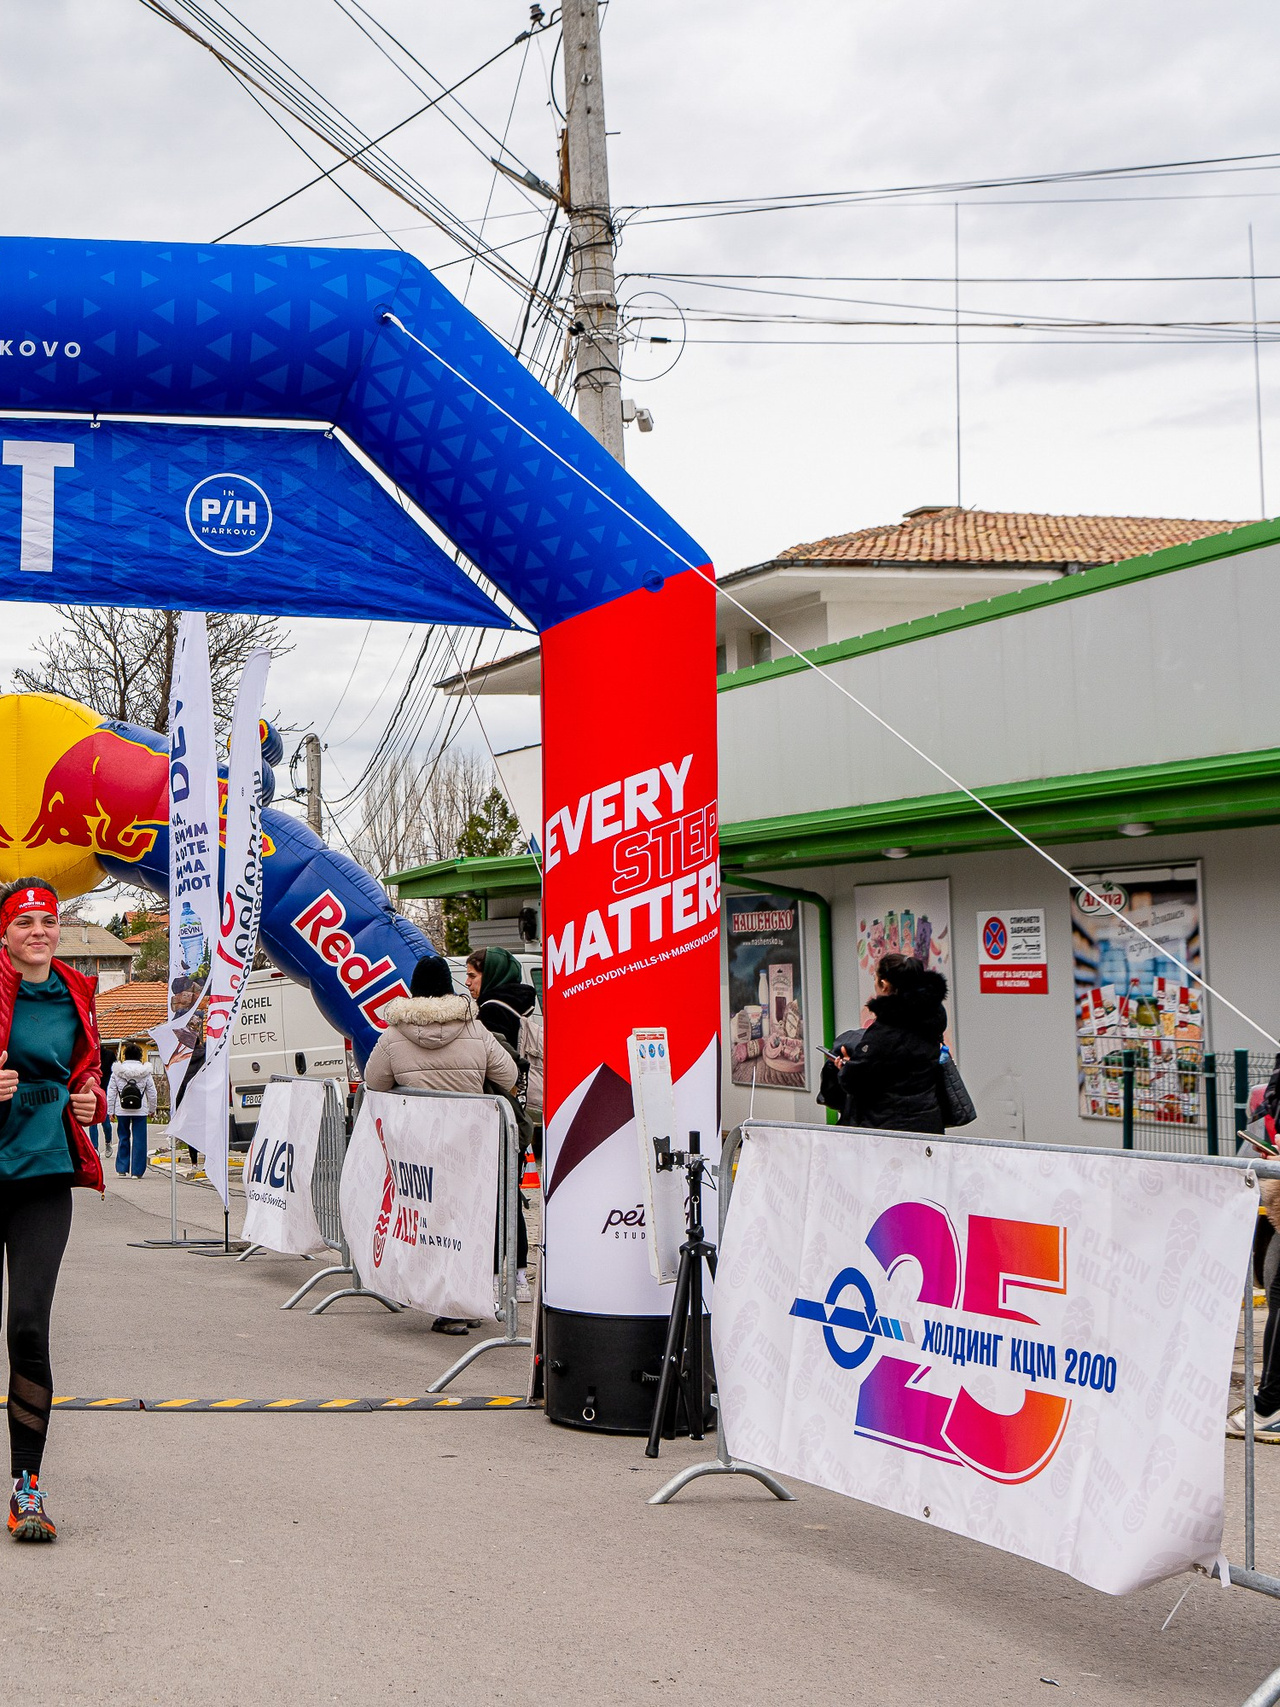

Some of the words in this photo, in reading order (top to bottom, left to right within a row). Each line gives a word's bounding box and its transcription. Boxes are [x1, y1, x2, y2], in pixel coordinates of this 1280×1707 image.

[223, 489, 235, 497] IN
[201, 498, 257, 526] P/H
[201, 526, 257, 536] MARKOVO
[545, 753, 694, 874] EVERY
[612, 798, 718, 895] STEP
[732, 909, 795, 933] НАШЕНСКО
[291, 889, 397, 999] Red
[21, 1087, 59, 1108] PUMA
[921, 1319, 1003, 1369] ХОЛДИНГ
[1009, 1337, 1057, 1383] КЦМ
[1064, 1348, 1117, 1394] 2000
